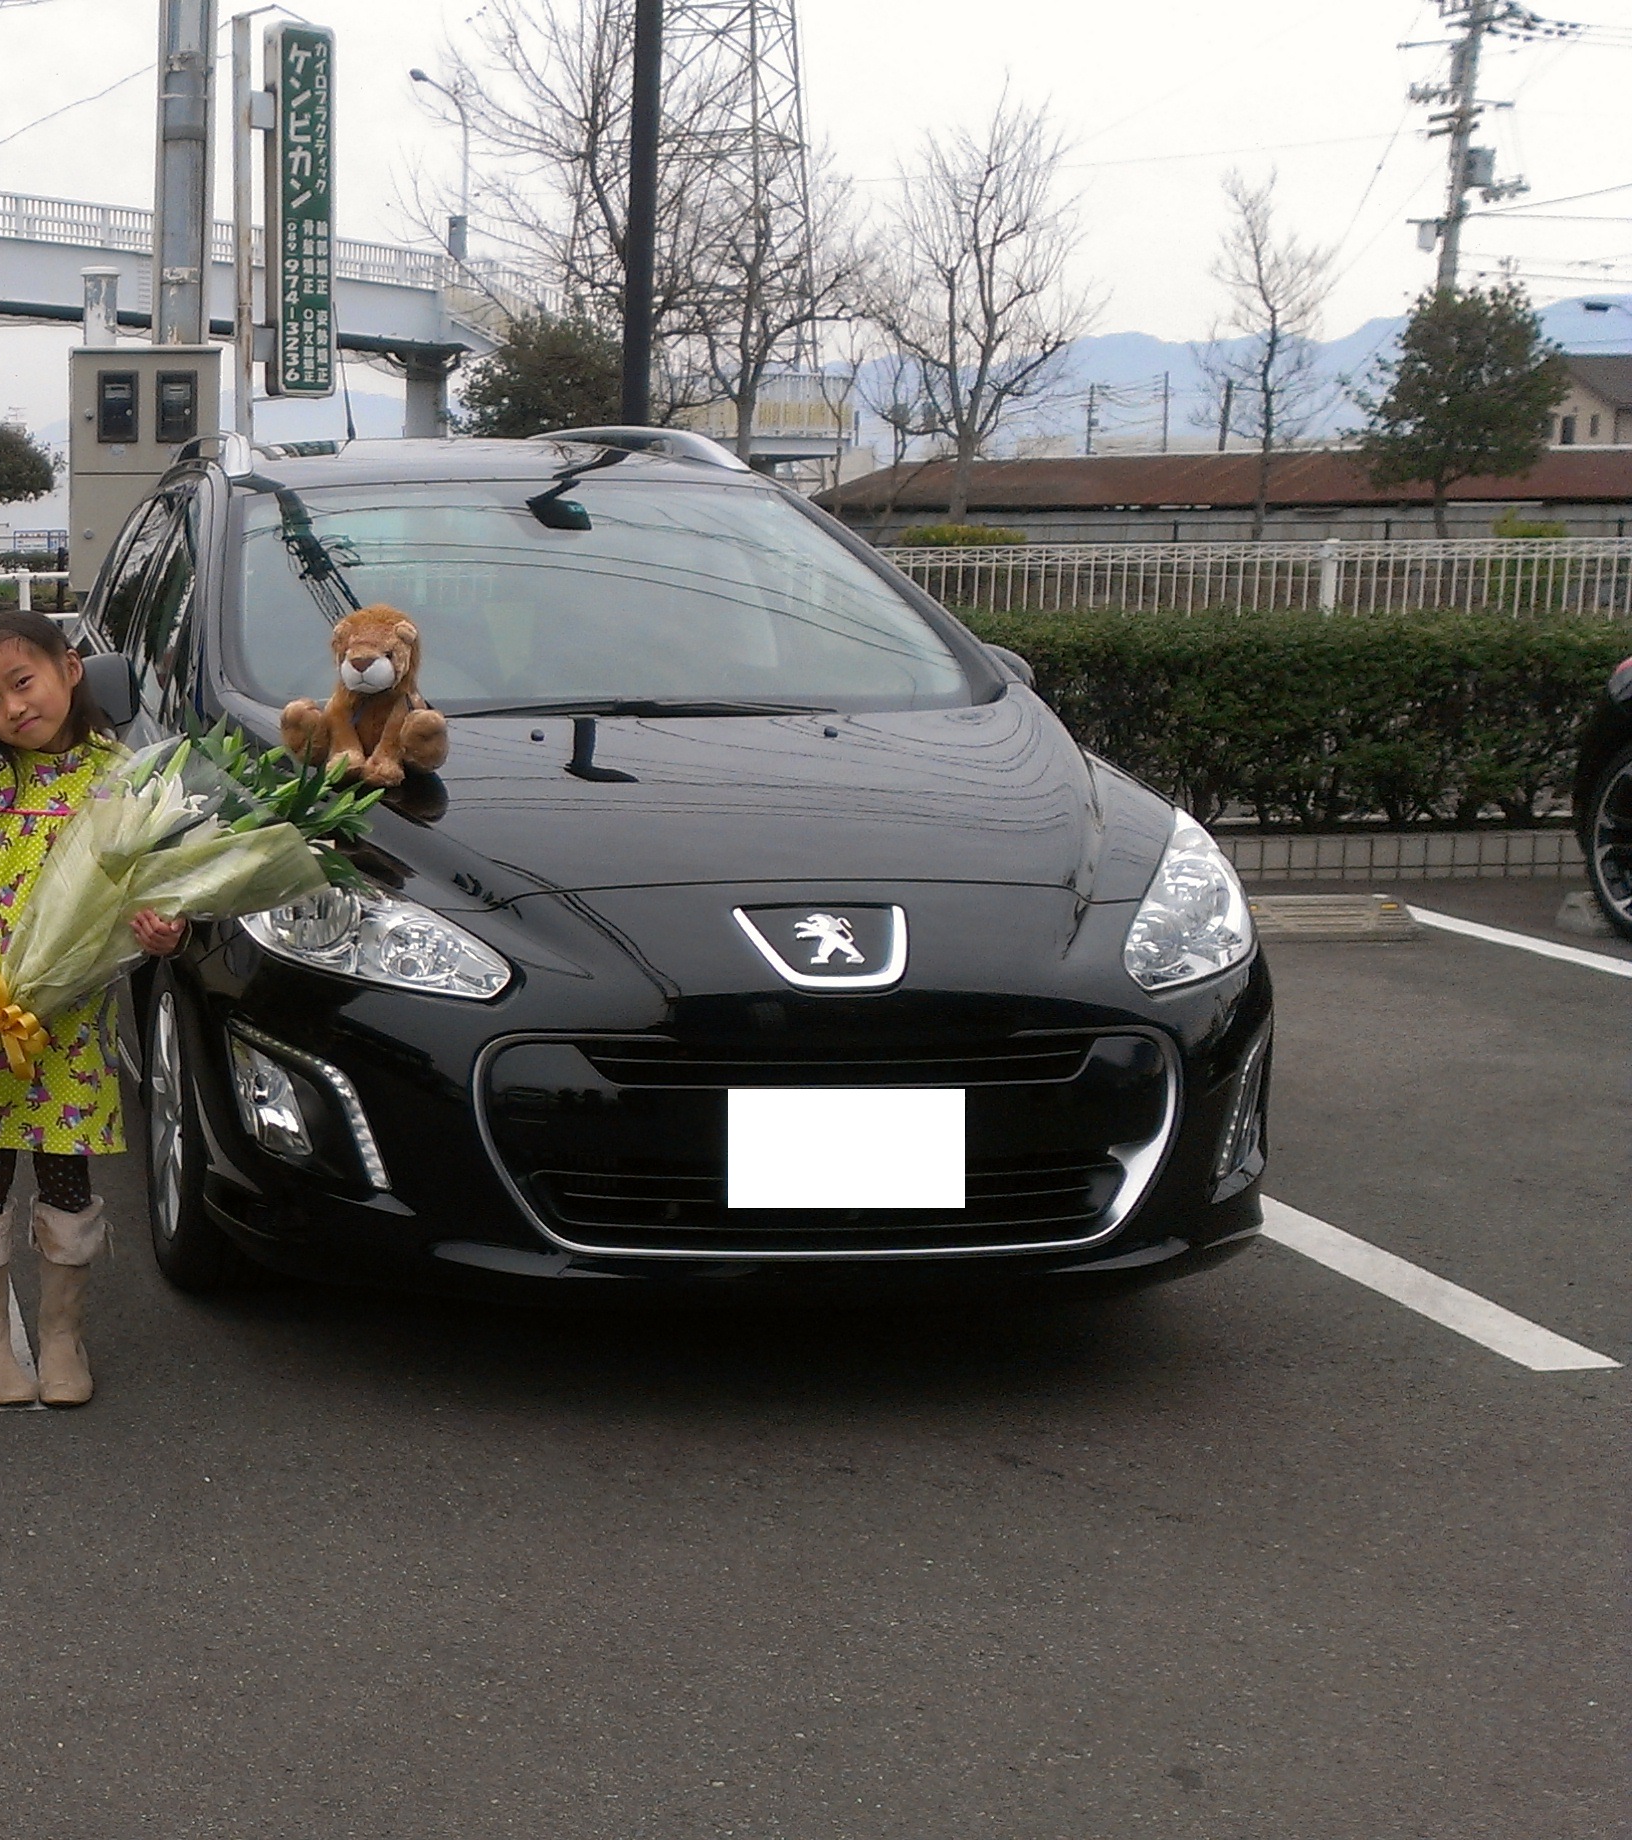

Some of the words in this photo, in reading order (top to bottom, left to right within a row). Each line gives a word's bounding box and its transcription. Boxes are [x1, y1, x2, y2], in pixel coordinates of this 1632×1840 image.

[288, 42, 312, 209] ケンビカン
